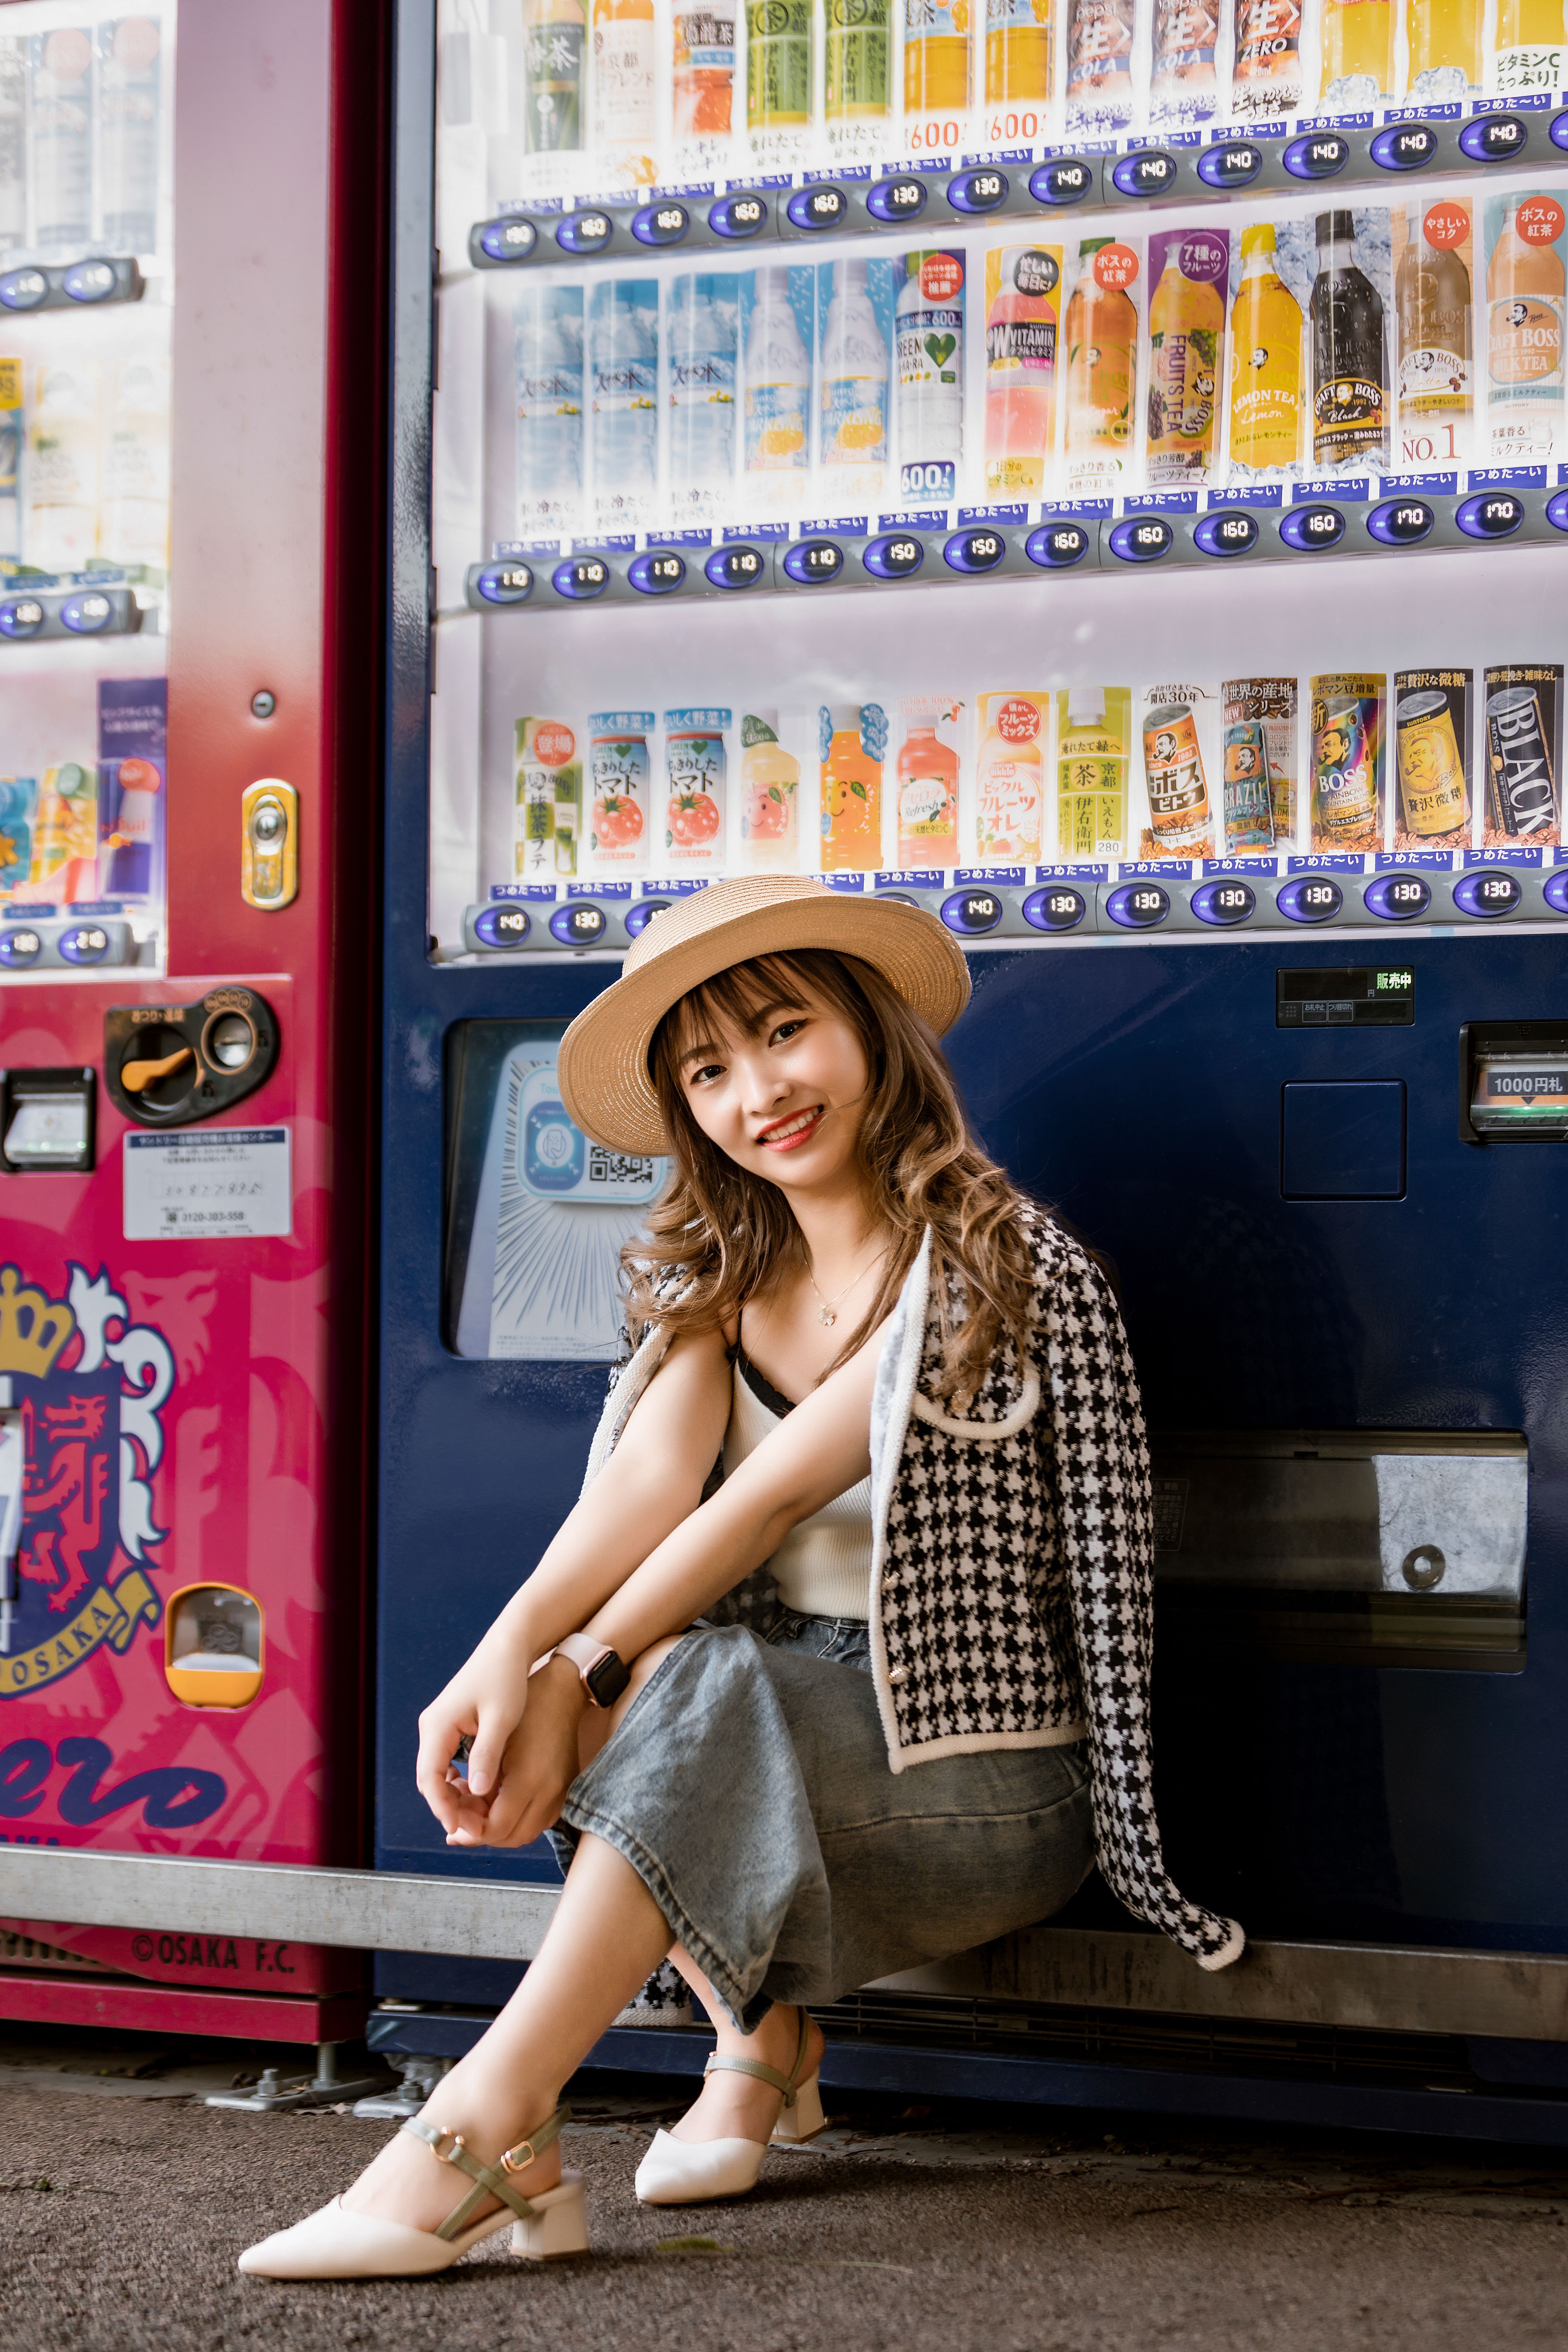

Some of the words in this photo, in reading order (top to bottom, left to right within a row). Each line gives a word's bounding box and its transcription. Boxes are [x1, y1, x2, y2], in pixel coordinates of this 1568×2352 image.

[1076, 3, 1117, 23] pepsi
[1165, 11, 1200, 50] 生
[1079, 20, 1113, 59] 生
[1240, 38, 1288, 63] ZERO
[1073, 57, 1117, 81] COLA
[1157, 49, 1201, 73] COLA
[1497, 53, 1561, 72] ビタミンC
[1497, 70, 1559, 93] たっぷり!
[1491, 124, 1516, 141] 140
[1401, 133, 1427, 150] 140
[1227, 151, 1251, 168] 140
[1314, 143, 1338, 159] 140
[1058, 169, 1082, 185] 140
[1142, 160, 1166, 177] 140
[894, 186, 918, 203] 130
[976, 177, 999, 195] 130
[735, 203, 759, 219] 160
[814, 194, 838, 211] 160
[1426, 217, 1467, 230] やさしい
[1521, 209, 1557, 222] ボスの
[1437, 229, 1456, 241] コク
[1527, 224, 1553, 237] 紅茶
[1097, 255, 1132, 267] ボスの
[1183, 245, 1221, 260] 7種の
[1020, 256, 1053, 274] 忙しい
[1182, 259, 1221, 273] フルーツ
[1103, 270, 1127, 283] 紅茶
[1010, 328, 1054, 346] VITAMIN
[1521, 328, 1561, 348] BOSS
[898, 338, 922, 357] REEN
[1168, 335, 1186, 396] FRUITS
[1400, 353, 1418, 380] CRAFT
[1437, 352, 1462, 373] BOSS
[1522, 355, 1548, 370] TEA
[1233, 389, 1271, 414] LEMON
[1274, 389, 1295, 406] TEA
[1315, 385, 1336, 416] CRAFT
[1355, 383, 1381, 406] BOSS
[1167, 398, 1184, 433] TEA
[1185, 398, 1212, 436] BOSS
[1241, 408, 1284, 425] Lemon
[1327, 406, 1363, 424] Black
[996, 462, 1022, 471] 1日分の
[1398, 509, 1423, 524] 170
[1487, 502, 1513, 518] 170
[1223, 521, 1248, 537] 160
[1310, 515, 1334, 531] 160
[1055, 533, 1079, 548] 160
[1139, 527, 1162, 542] 160
[891, 544, 914, 559] 150
[972, 538, 995, 554] 150
[732, 555, 756, 570] 110
[811, 549, 834, 564] 110
[579, 564, 603, 581] 110
[655, 560, 678, 575] 110
[1407, 671, 1466, 689] 贅沢な微糖
[1151, 692, 1200, 704] 開店30年
[1229, 683, 1293, 702] 世界の産地
[1009, 702, 1028, 712] 懐かし
[1224, 707, 1239, 719] NEW
[1248, 701, 1292, 713] シリーズ
[999, 713, 1038, 725] フルーツ
[1311, 701, 1326, 732] 新
[1406, 714, 1431, 728] SUNTORY
[1001, 724, 1036, 737] ミックス
[1491, 723, 1500, 753] BOSS
[1061, 740, 1120, 754] 淹れたて緑へ
[1074, 764, 1096, 787] 茶
[1100, 762, 1116, 787] 京都
[1156, 760, 1201, 794] ボス
[1319, 763, 1368, 793] BOSS
[1436, 764, 1458, 790] Boss
[1497, 703, 1555, 836] BLACK
[594, 773, 637, 797] トマト
[670, 770, 713, 793] トマト
[985, 781, 1025, 794] ビックル
[1224, 782, 1266, 809] BRAZIL
[1323, 797, 1353, 807] MOUNTAIN
[1353, 790, 1370, 801] BLEND
[1326, 785, 1364, 801] RAINBOW
[1407, 786, 1462, 813] 贅沢微糖
[905, 800, 938, 817] Refresh
[979, 795, 1036, 813] フルーツ
[1159, 793, 1196, 811] ビトウ
[987, 814, 1021, 832] オレ
[1075, 797, 1093, 854] 伊右衛門
[1102, 797, 1114, 838] いえもん
[1236, 821, 1251, 830] 微糖
[530, 793, 547, 871] 抹茶ラテ
[915, 823, 948, 834] 天然ビタミンC
[1355, 825, 1375, 836] コーヒー
[1098, 842, 1119, 852] 280
[813, 875, 860, 884] めた〜い
[1307, 887, 1332, 903] 130
[1395, 884, 1420, 900] 130
[1485, 881, 1510, 897] 130
[969, 899, 992, 914] 140
[1052, 896, 1075, 912] 130
[1135, 893, 1159, 908] 130
[1221, 890, 1245, 906] 130
[501, 914, 524, 929] 140
[576, 912, 599, 927] 130
[1376, 971, 1412, 990] 販売中
[1367, 989, 1375, 998] 円
[1304, 1003, 1326, 1011] お札中止
[1328, 1002, 1353, 1011] つり銭切れ
[1494, 1077, 1563, 1093] 1000円札
[11, 1604, 112, 1686] OSAKA
[256, 1942, 295, 1974] F.C.
